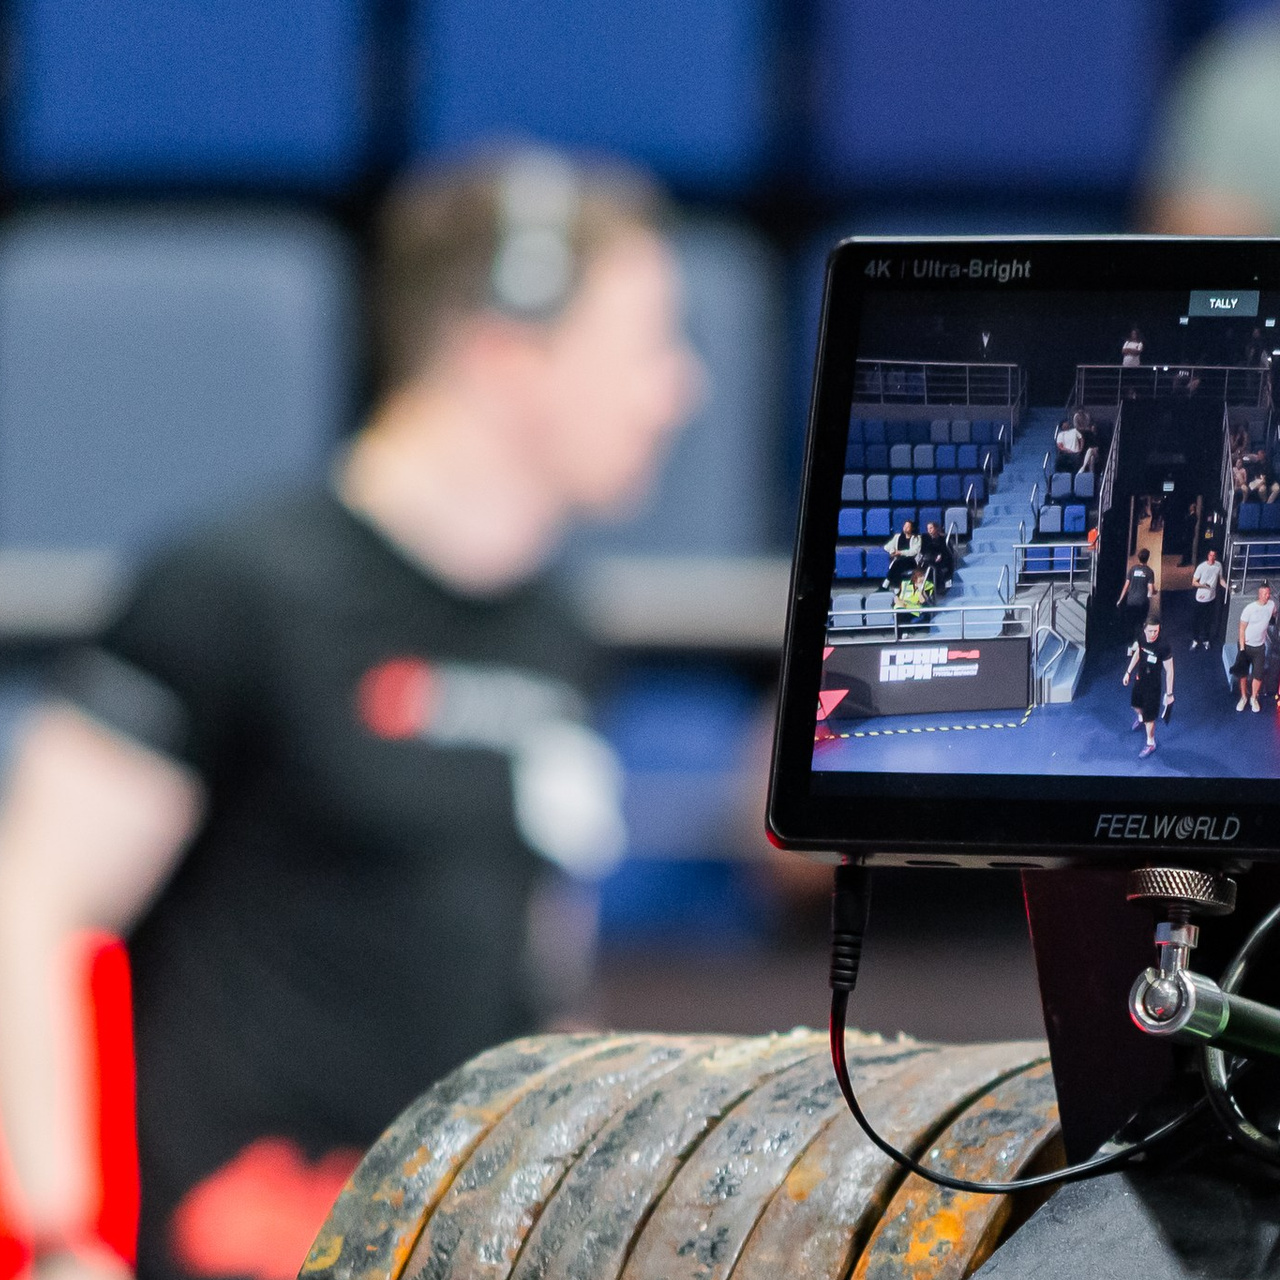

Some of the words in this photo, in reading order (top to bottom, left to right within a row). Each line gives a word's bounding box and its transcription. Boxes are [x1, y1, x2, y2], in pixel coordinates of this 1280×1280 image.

[864, 259, 892, 279] 4K
[913, 258, 1032, 283] Ultra-Bright
[1209, 298, 1239, 309] TALLY
